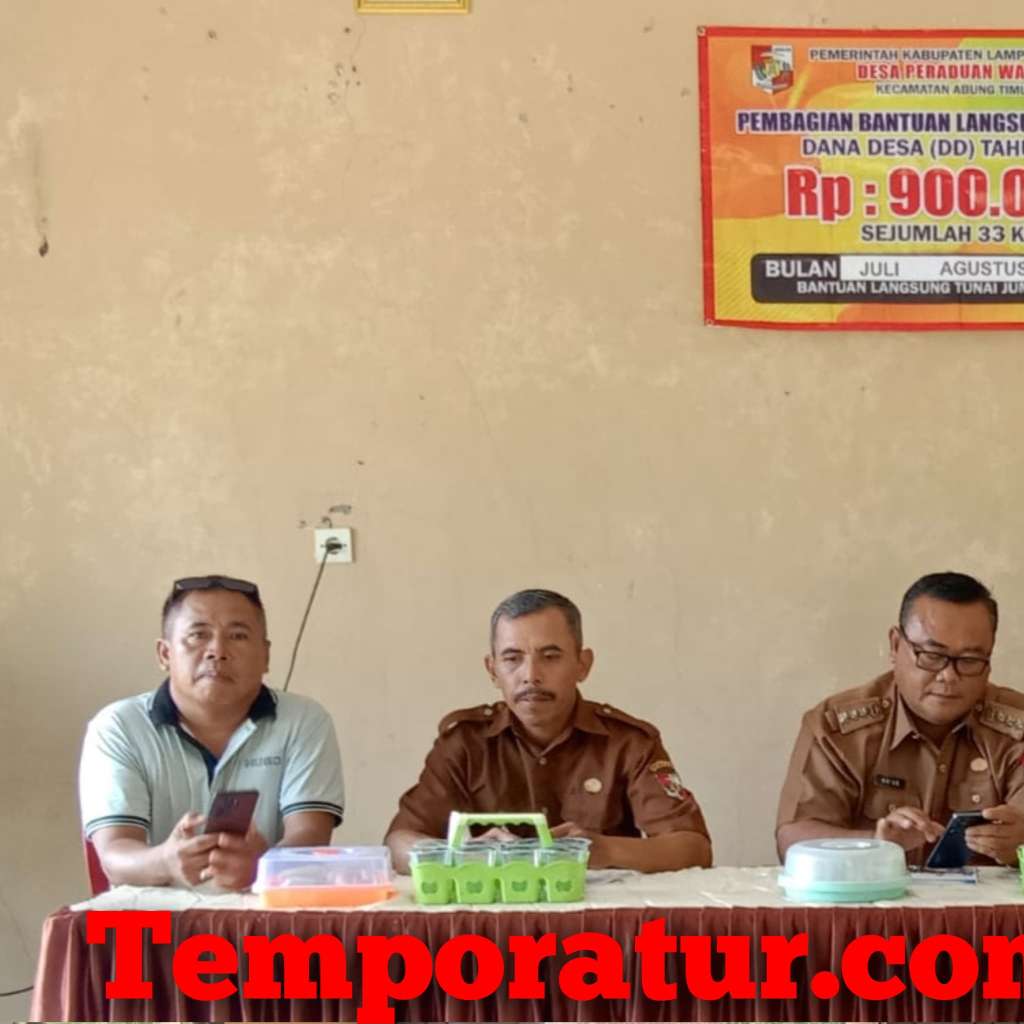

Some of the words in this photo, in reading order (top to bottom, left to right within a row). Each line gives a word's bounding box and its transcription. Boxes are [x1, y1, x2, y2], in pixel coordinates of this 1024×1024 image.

[810, 49, 898, 60] PEMERINTAH
[903, 49, 982, 60] KABUPATEN
[858, 64, 900, 79] DESA
[906, 64, 992, 79] PERADUAN
[876, 84, 949, 94] KECAMATAN
[953, 84, 995, 95] ABUNG
[738, 112, 853, 132] PEMBAGIAN
[859, 112, 951, 132] BANTUAN
[803, 139, 861, 155] DANA
[868, 139, 924, 156] DESA
[931, 139, 975, 160] (DD)
[787, 168, 851, 221] Rp
[861, 225, 971, 242] SEJUMLAH
[978, 226, 1005, 242] 33
[765, 260, 837, 278] BULAN
[859, 262, 899, 277] JULI
[797, 281, 867, 294] BANTUAN
[870, 281, 950, 294] LANGSUNG
[955, 282, 998, 294] TUNAI
